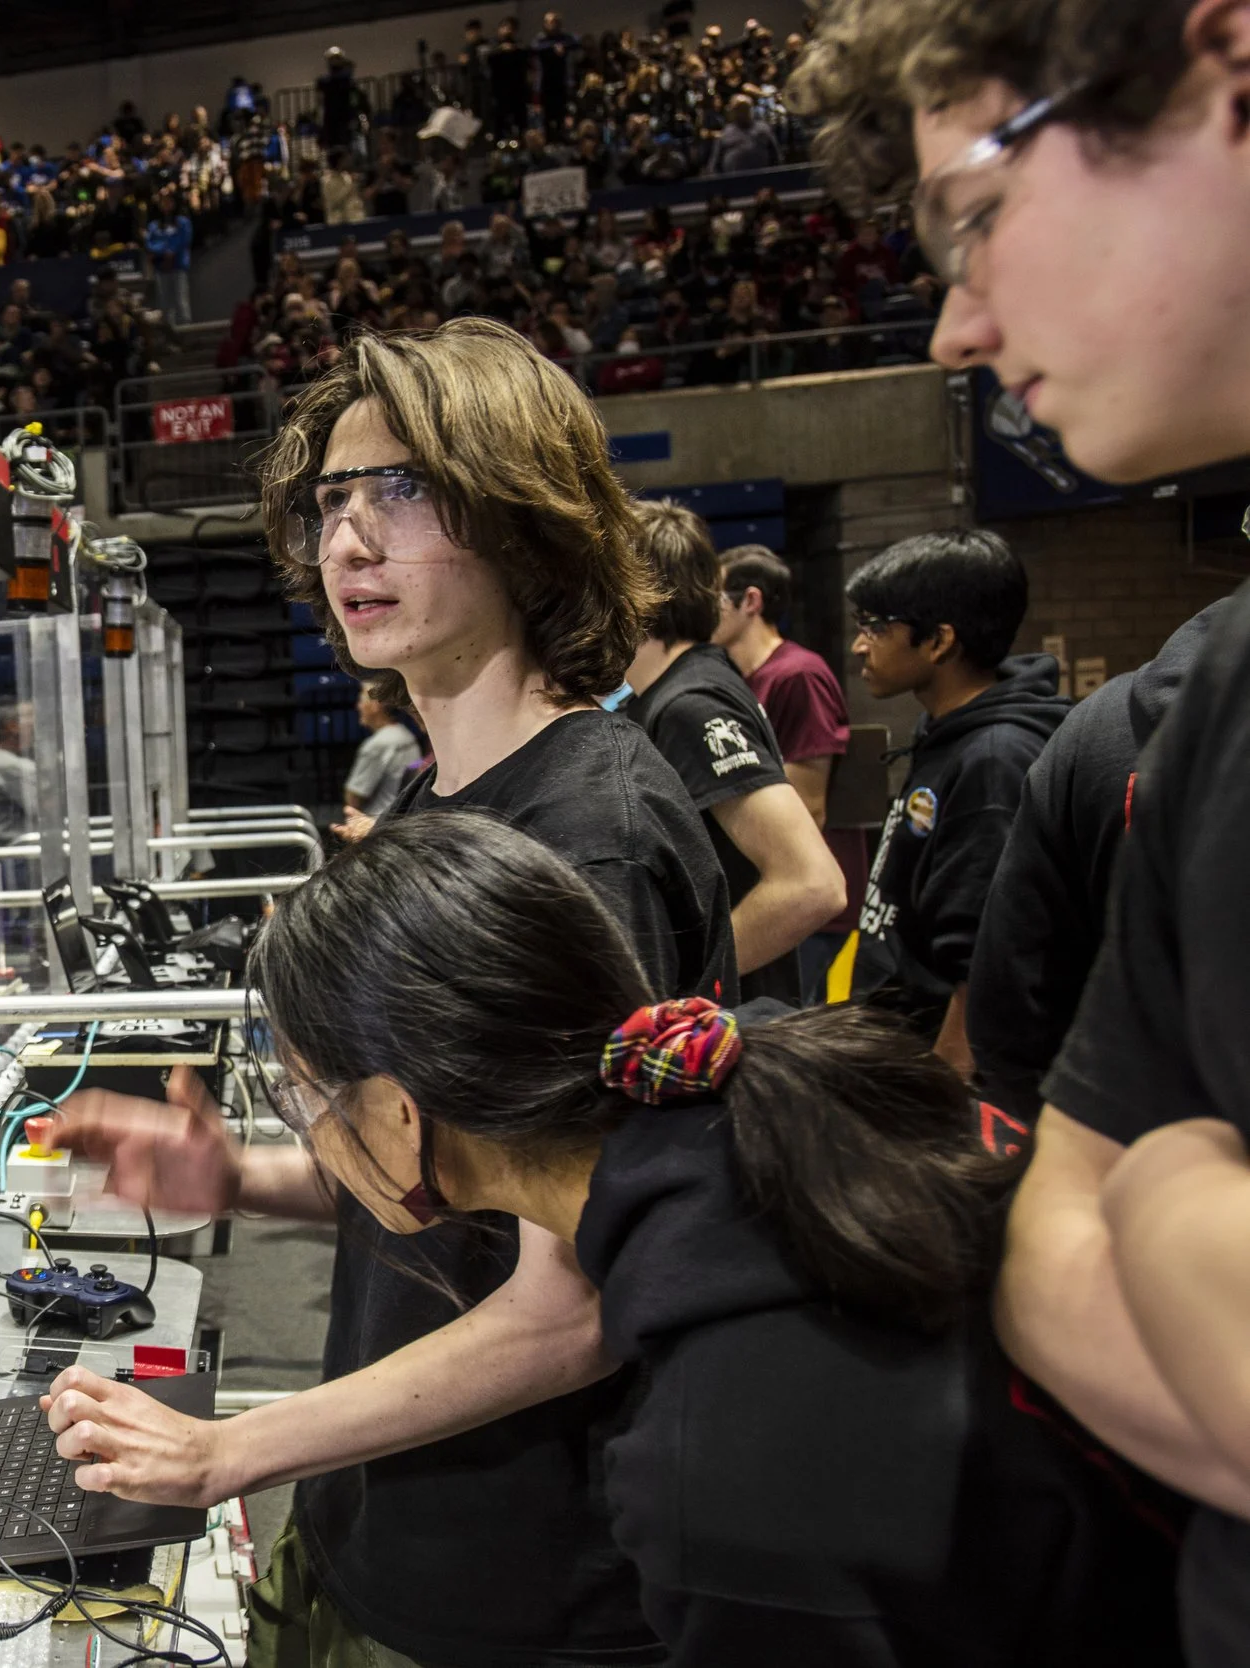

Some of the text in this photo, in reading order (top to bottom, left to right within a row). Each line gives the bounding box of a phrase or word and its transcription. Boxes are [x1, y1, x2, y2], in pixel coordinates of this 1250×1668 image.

[159, 403, 226, 423] NOT AN
[171, 419, 211, 440] EXIT
